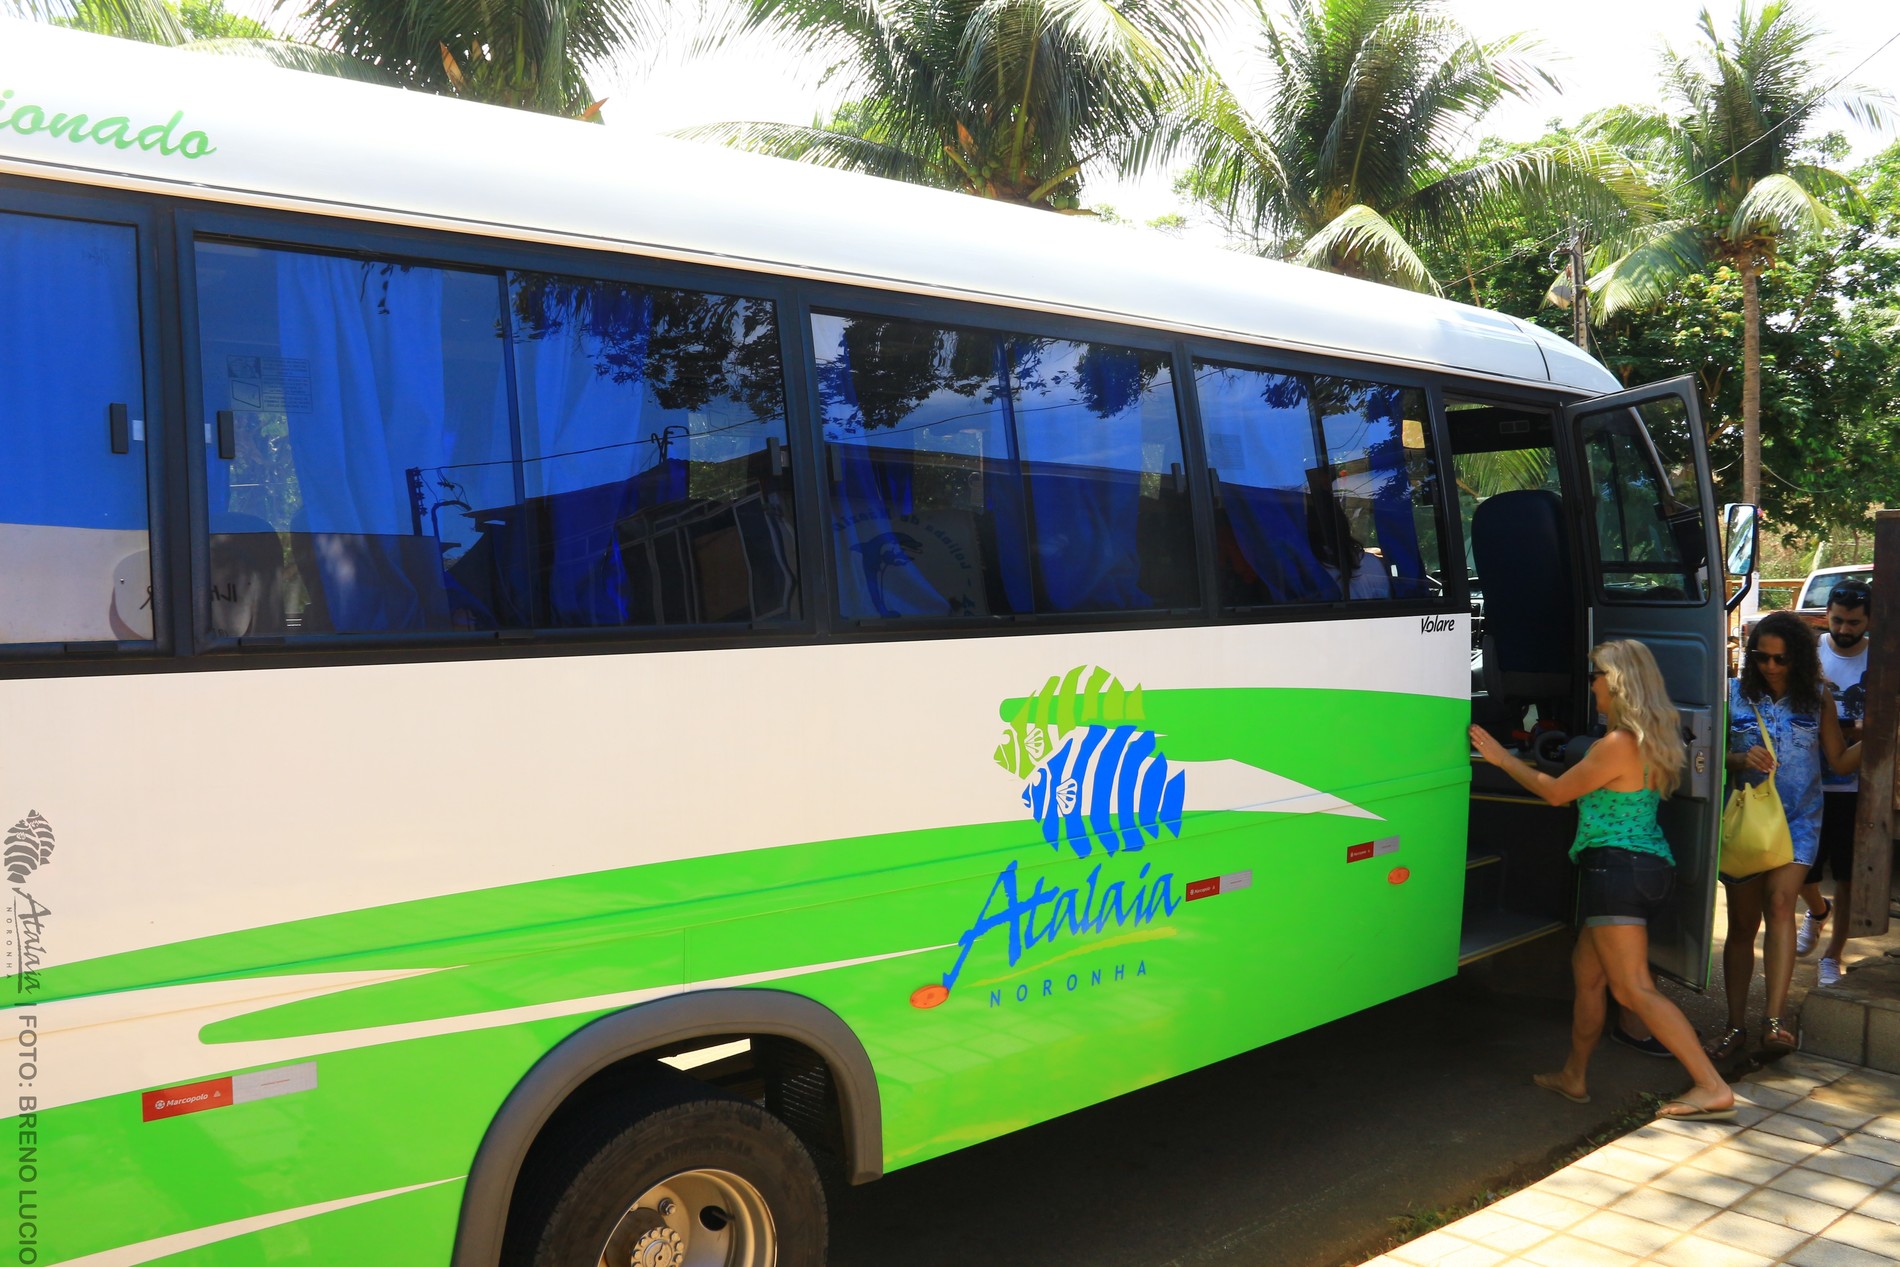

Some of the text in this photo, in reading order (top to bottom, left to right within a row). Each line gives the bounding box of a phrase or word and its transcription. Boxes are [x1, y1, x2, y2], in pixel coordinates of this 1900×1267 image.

[1421, 615, 1455, 634] Volare
[942, 860, 1181, 992] Atalaia
[990, 960, 1146, 1008] NORONHA
[166, 1092, 209, 1107] Marcopolo
